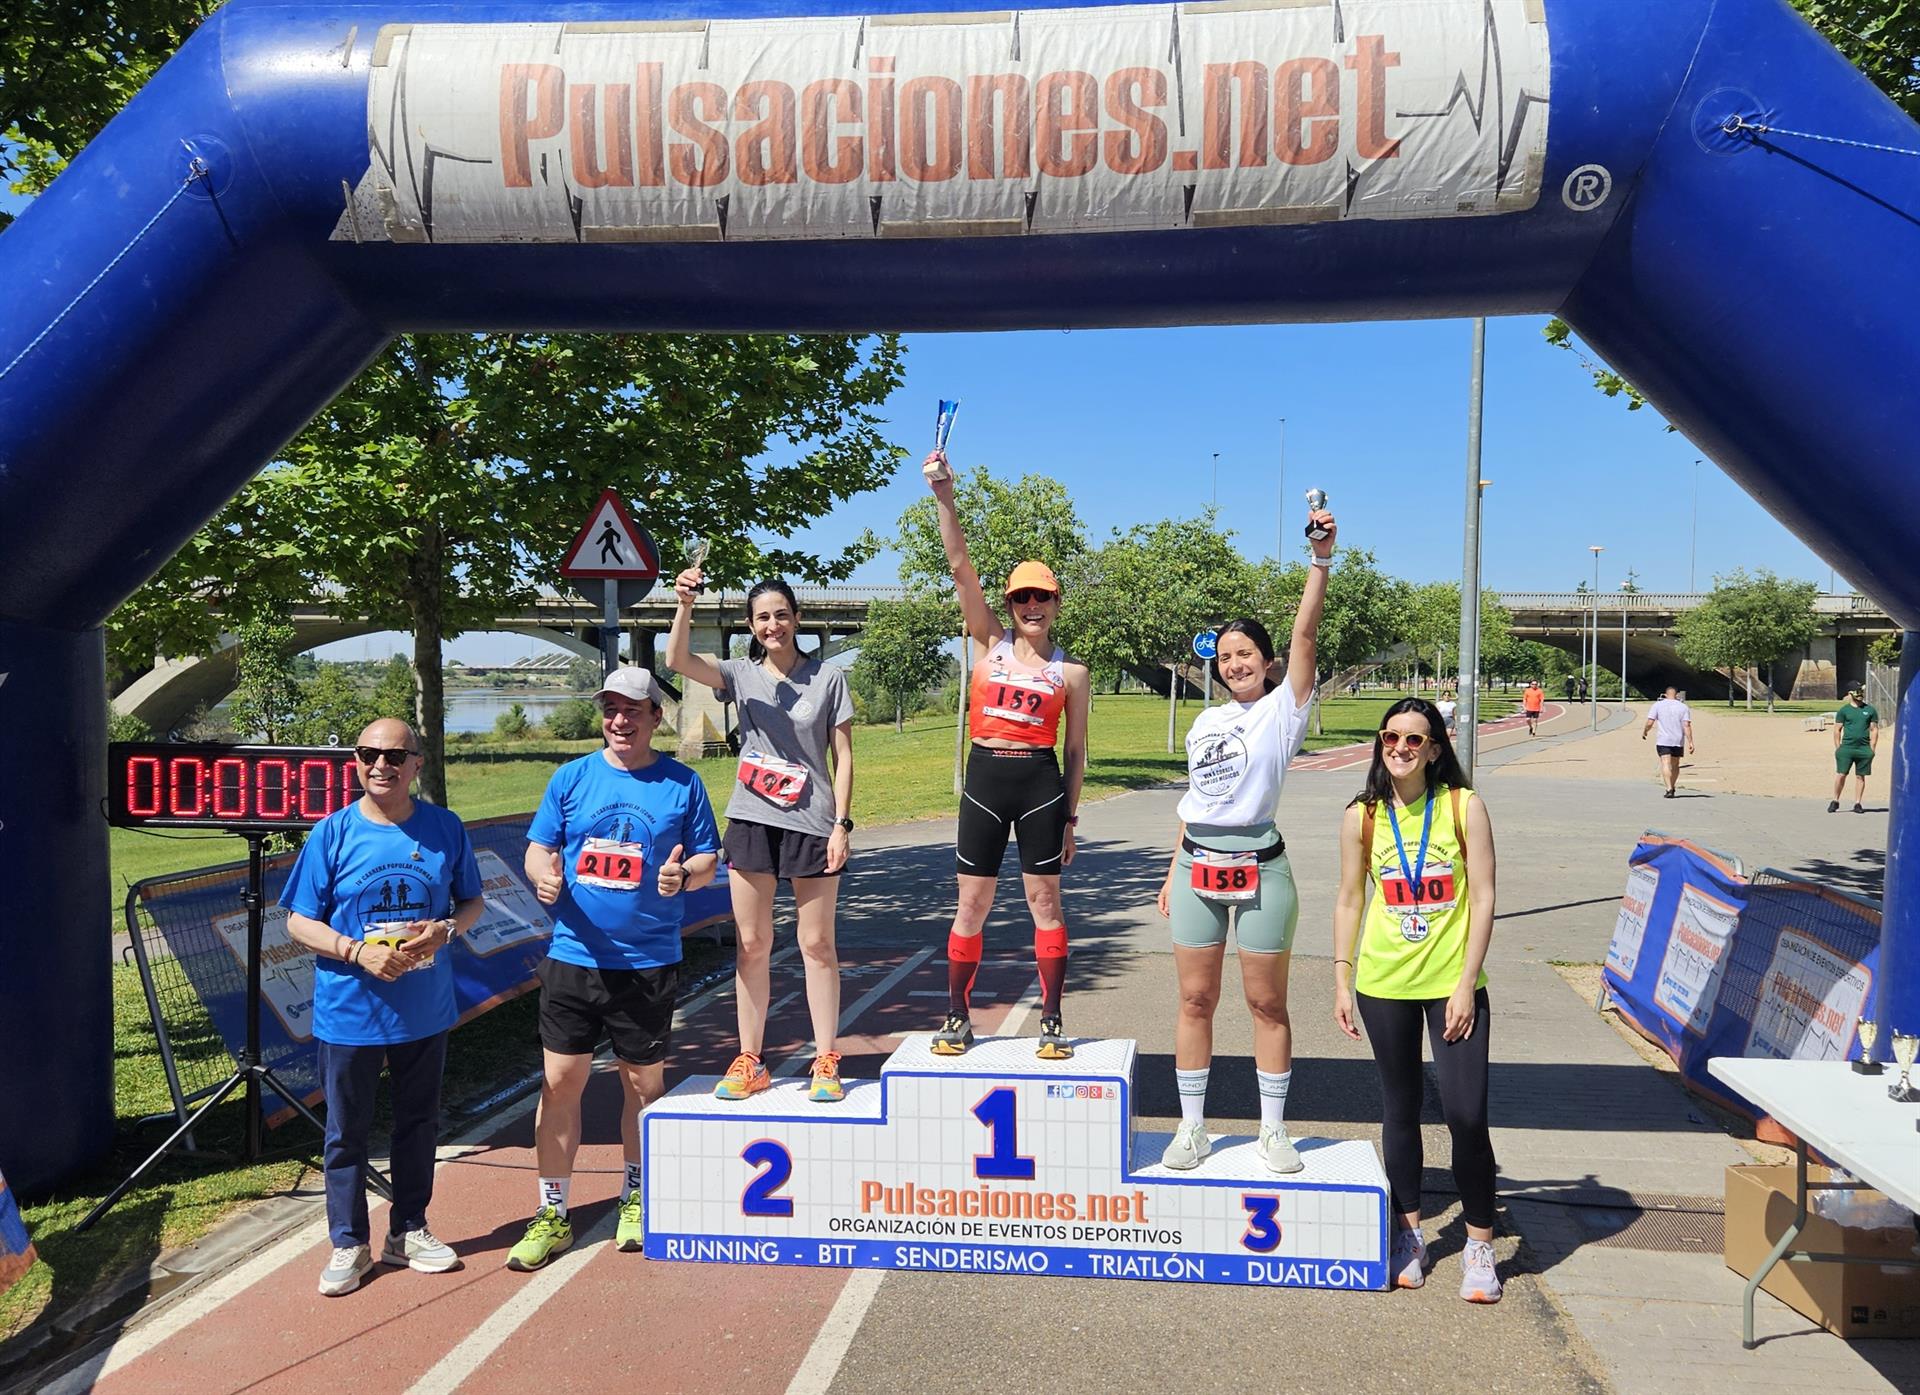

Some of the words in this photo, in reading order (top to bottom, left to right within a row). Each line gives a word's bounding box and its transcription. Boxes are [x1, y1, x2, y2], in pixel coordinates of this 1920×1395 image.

[501, 34, 1400, 189] Pulsaciones.net
[997, 687, 1043, 713] 159
[584, 854, 632, 879] 212
[1203, 868, 1248, 890] 158
[970, 1086, 1036, 1181] 1
[740, 1137, 794, 1218] 2
[861, 1180, 1149, 1224] Pulsaciones.net
[1239, 1193, 1283, 1253] 3
[829, 1217, 955, 1236] ORGANIZACIÓN
[962, 1222, 983, 1236] DE
[989, 1223, 1067, 1240] EVENTOS
[1073, 1226, 1182, 1244] DEPORTIVOS
[666, 1238, 779, 1262] RUNNING
[818, 1244, 857, 1265] BTT
[895, 1246, 1049, 1273] SENDERISMO
[1088, 1252, 1205, 1279] TRIATLÓN
[1248, 1260, 1368, 1287] DUATLÓN
